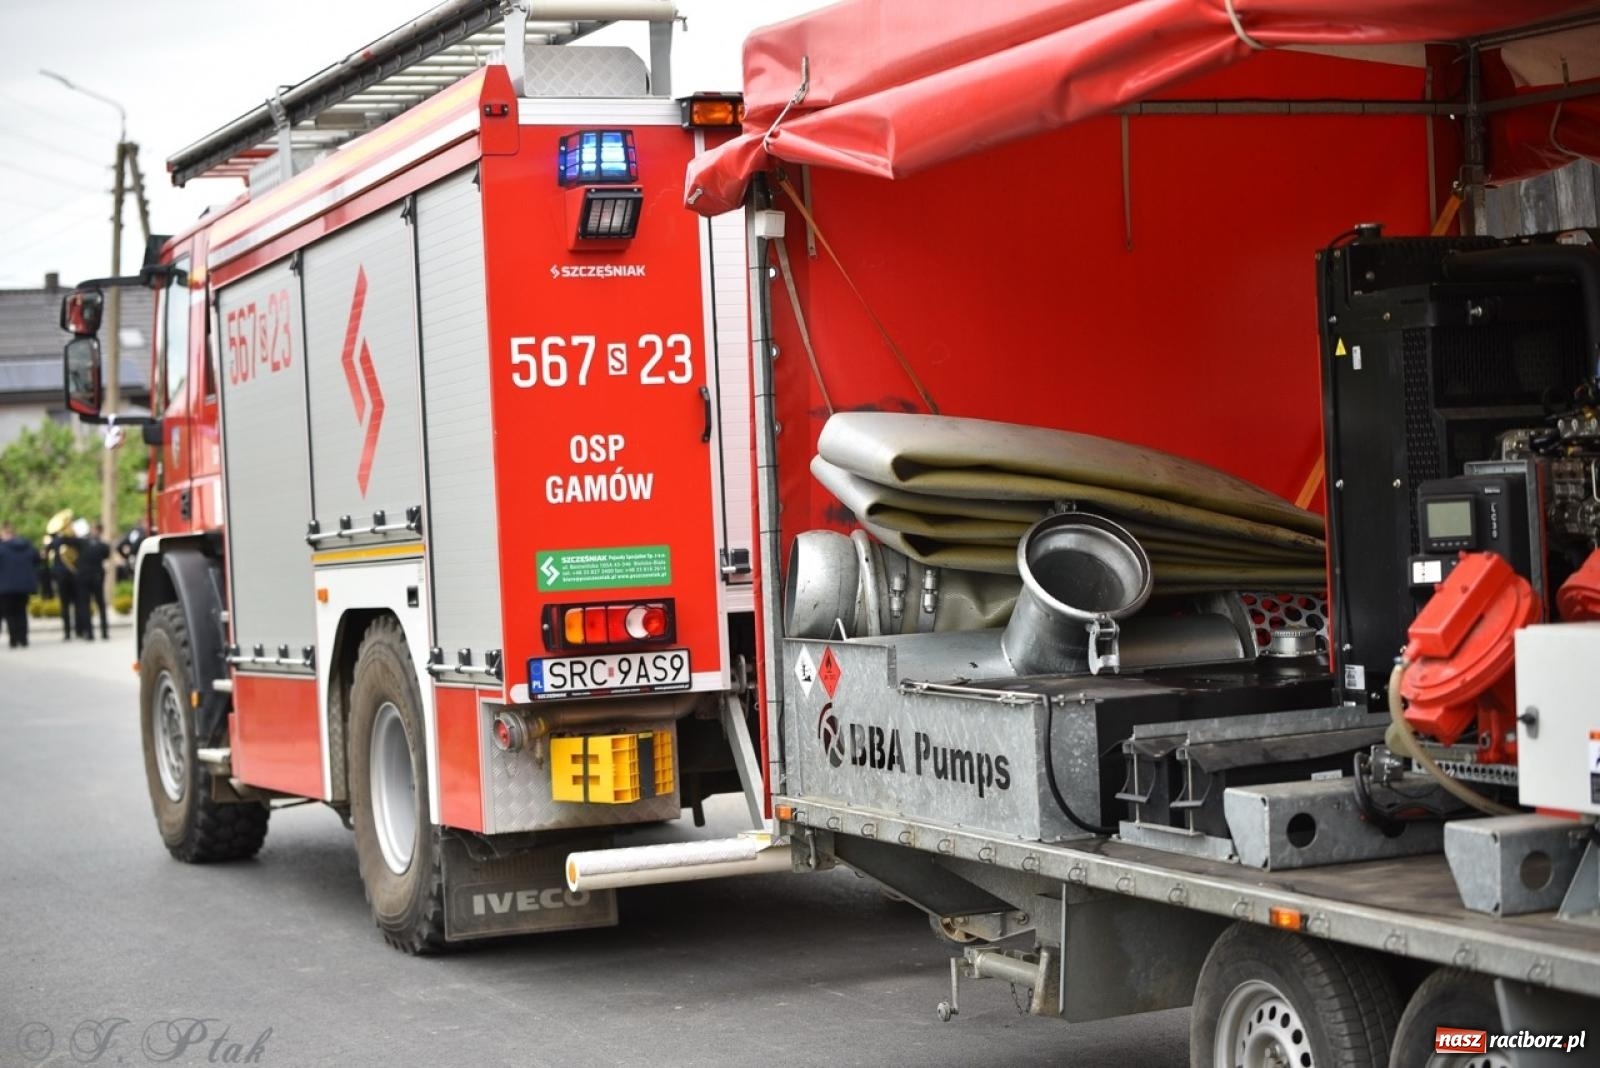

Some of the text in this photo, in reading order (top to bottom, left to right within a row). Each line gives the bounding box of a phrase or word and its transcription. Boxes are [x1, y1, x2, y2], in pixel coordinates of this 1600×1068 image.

[561, 264, 646, 279] SZCZĘŚNIAK
[227, 302, 256, 386] 567
[269, 289, 292, 372] 23
[510, 333, 693, 388] 567 S 23
[570, 434, 625, 463] OSP
[545, 466, 654, 504] GAMÓW
[532, 653, 684, 690] PL SRC 9AS9
[849, 723, 1011, 798] BBA Pumps
[473, 888, 590, 916] IVECO
